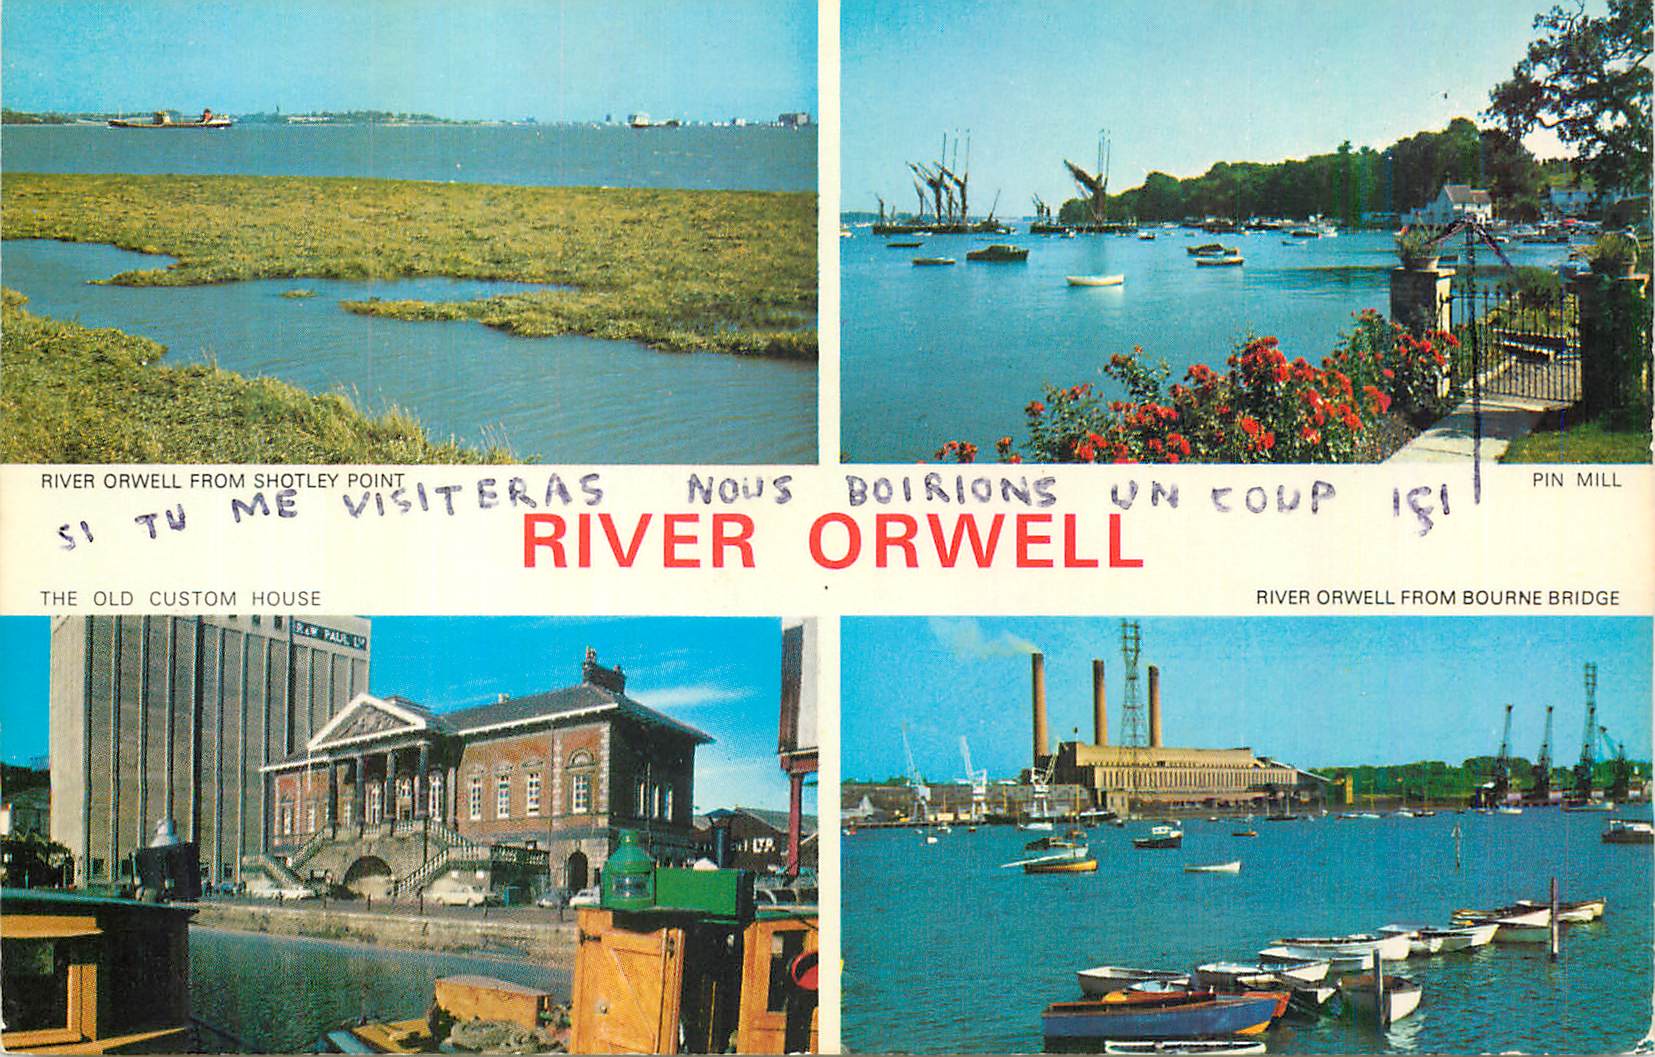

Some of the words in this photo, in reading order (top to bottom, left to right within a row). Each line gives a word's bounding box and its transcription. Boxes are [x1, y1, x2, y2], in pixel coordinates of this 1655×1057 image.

[58, 521, 94, 551] SI
[134, 503, 187, 539] TU
[231, 488, 298, 523] ME
[342, 473, 604, 519] VISITERAS
[688, 474, 792, 505] NOUS
[847, 474, 1056, 507] BOIRIONS
[1111, 480, 1179, 510] UN
[1211, 480, 1337, 514] COUP
